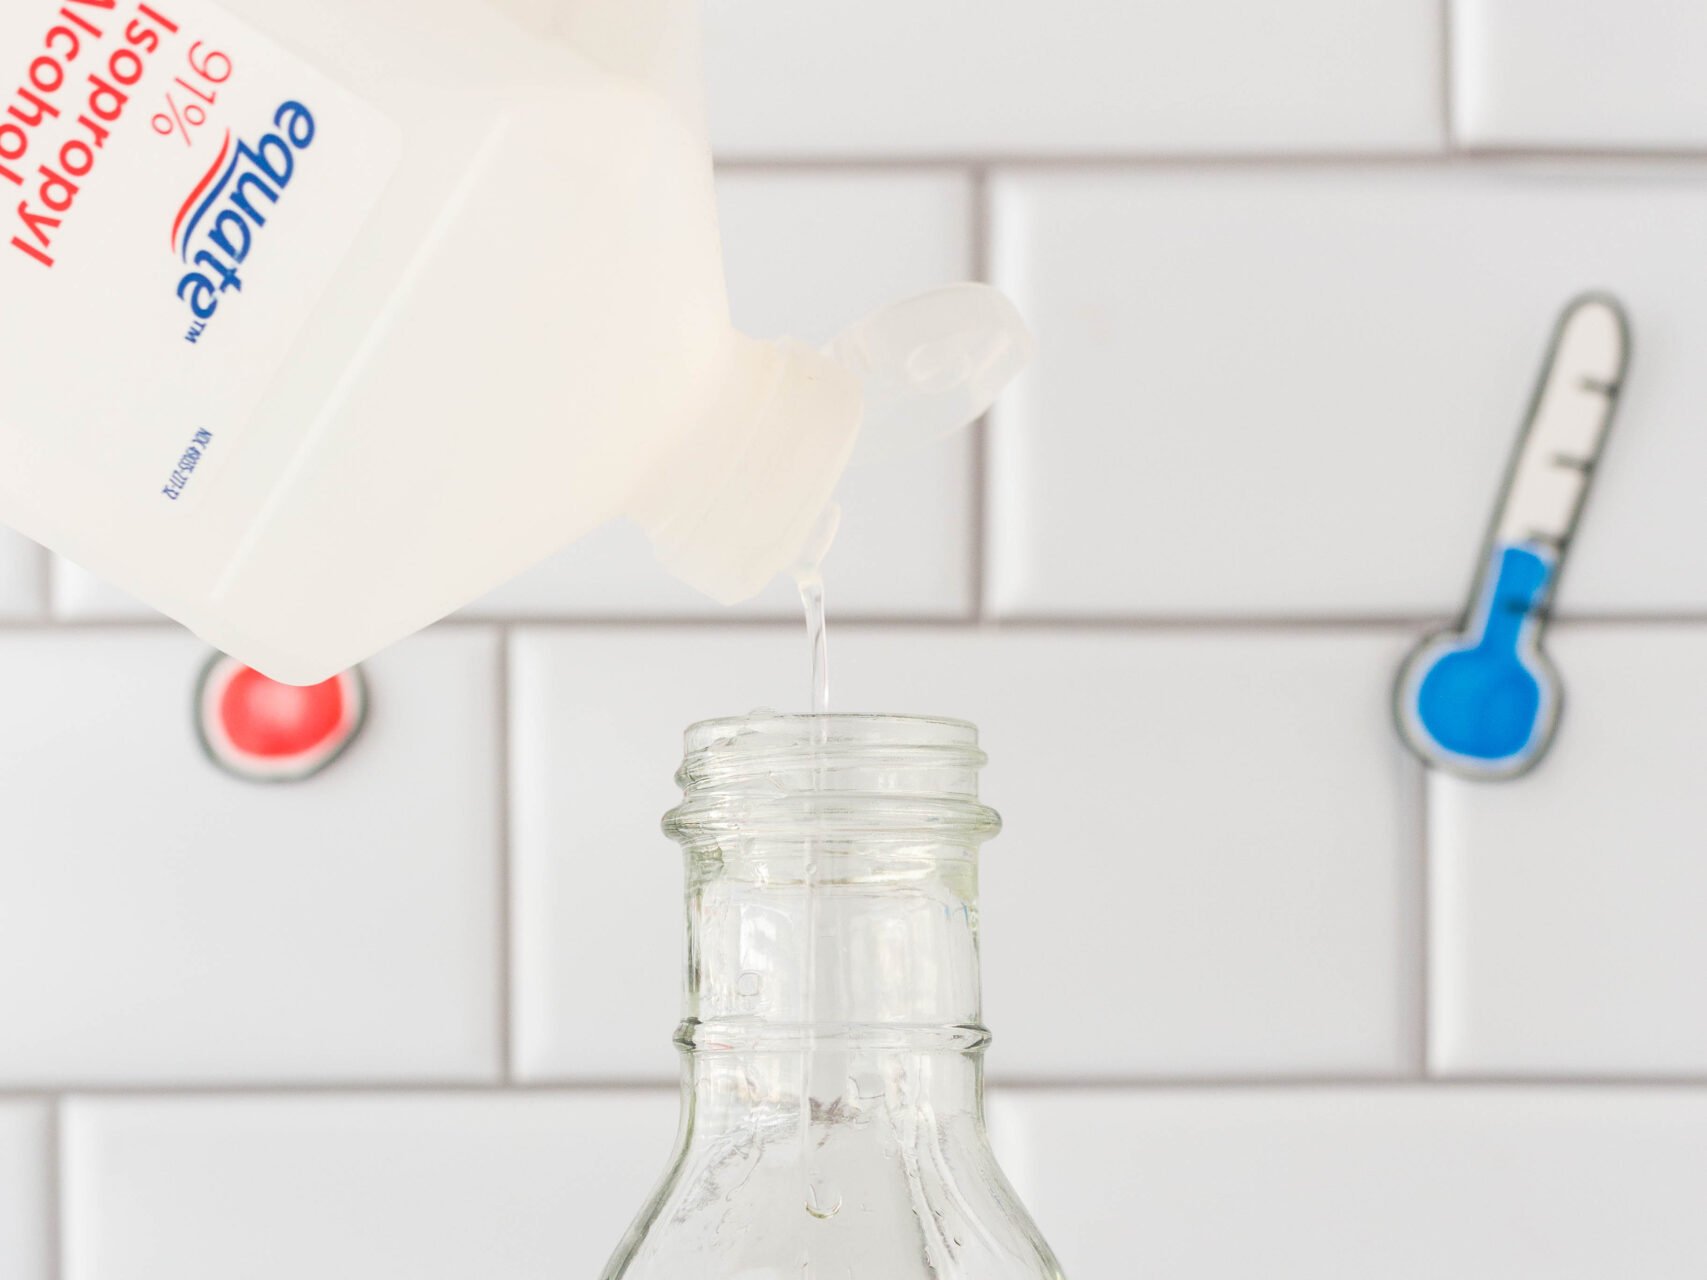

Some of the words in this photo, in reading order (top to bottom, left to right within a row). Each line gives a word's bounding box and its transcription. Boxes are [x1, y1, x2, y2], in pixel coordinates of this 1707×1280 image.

[10, 2, 180, 268] Isopropyl
[151, 40, 233, 147] 91%
[175, 99, 316, 320] equate
